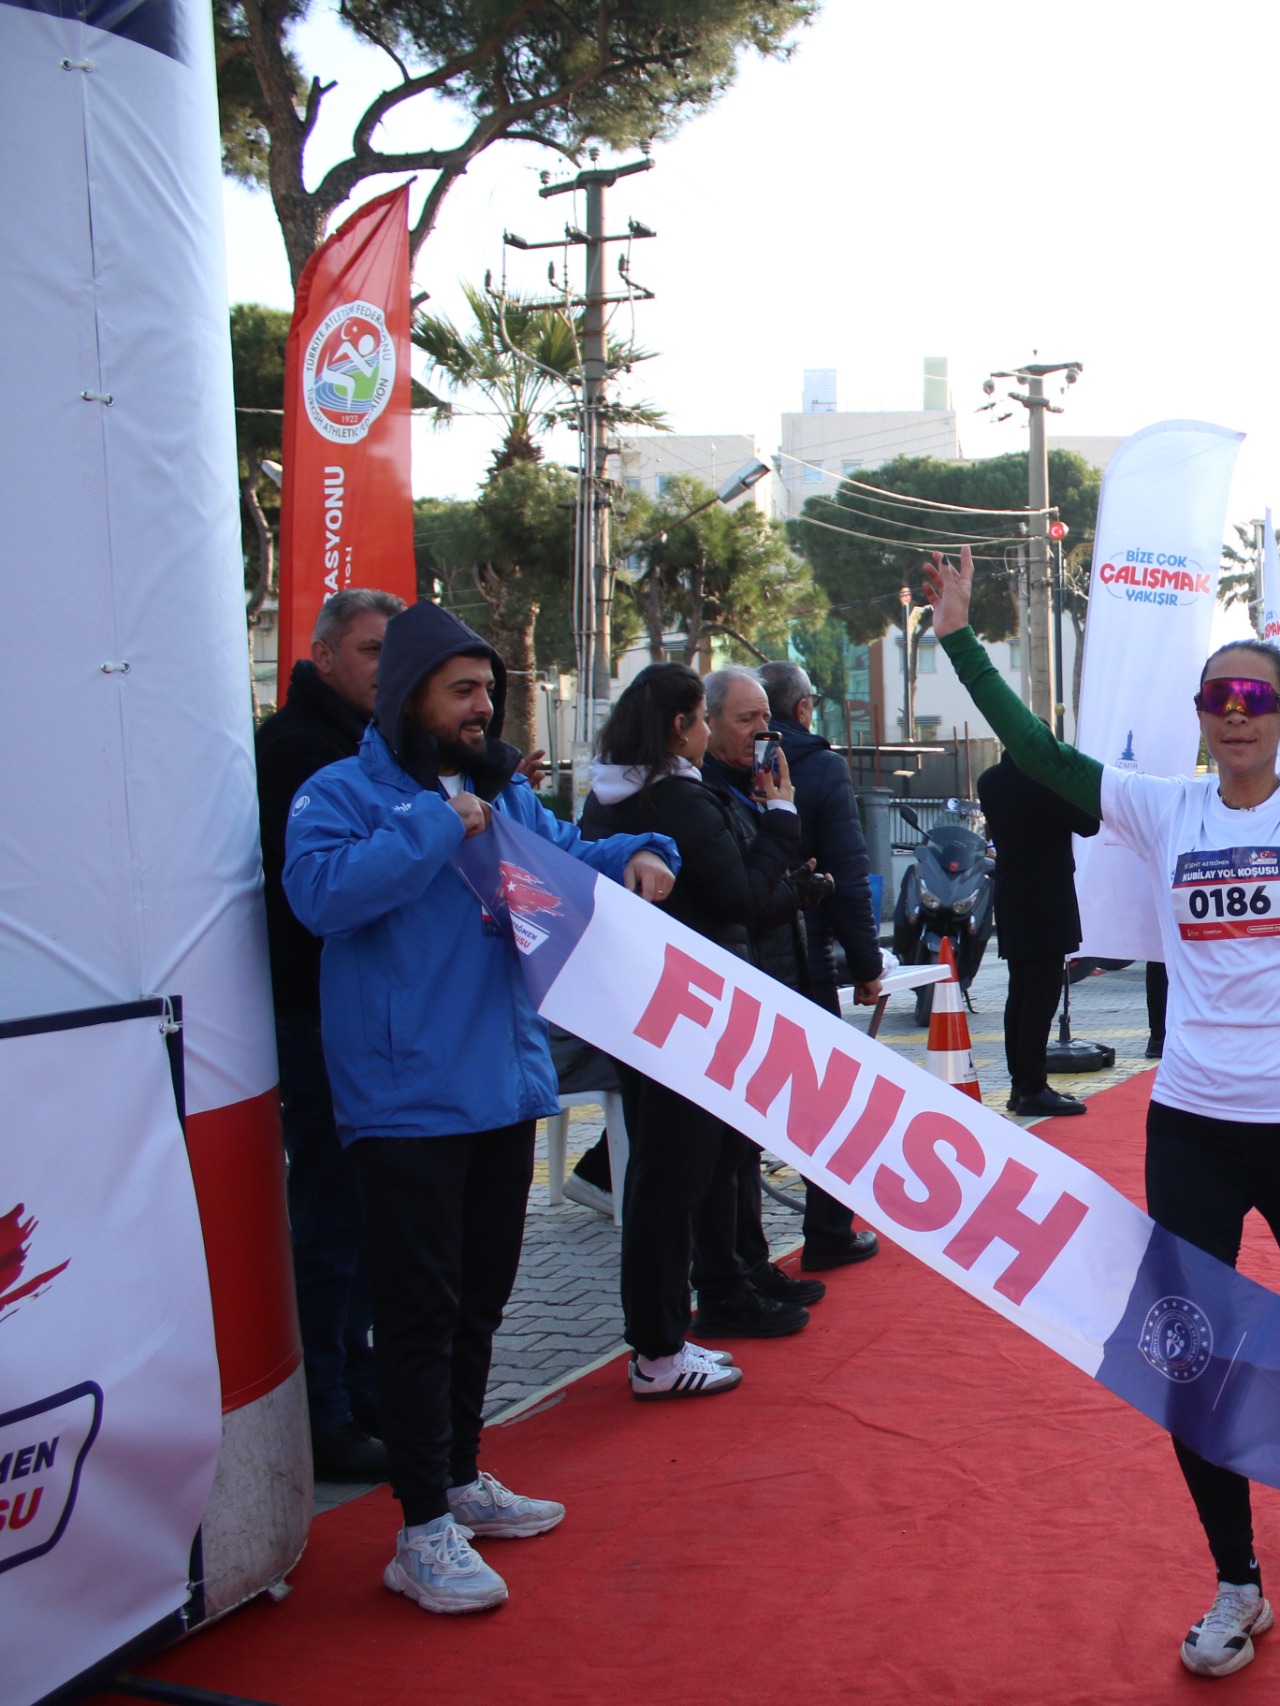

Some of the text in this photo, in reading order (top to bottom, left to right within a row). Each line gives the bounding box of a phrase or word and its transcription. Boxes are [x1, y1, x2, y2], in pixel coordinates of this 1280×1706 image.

[341, 414, 359, 424] 1922
[1126, 548, 1188, 568] BİZE ÇOK
[1100, 563, 1211, 594] ÇALIŞMAK
[1125, 589, 1179, 606] YAKIŞIR
[1182, 866, 1279, 881] KUBİLAY YOL KOŞUSU
[1189, 885, 1272, 919] 0186
[632, 942, 1089, 1307] FINISH
